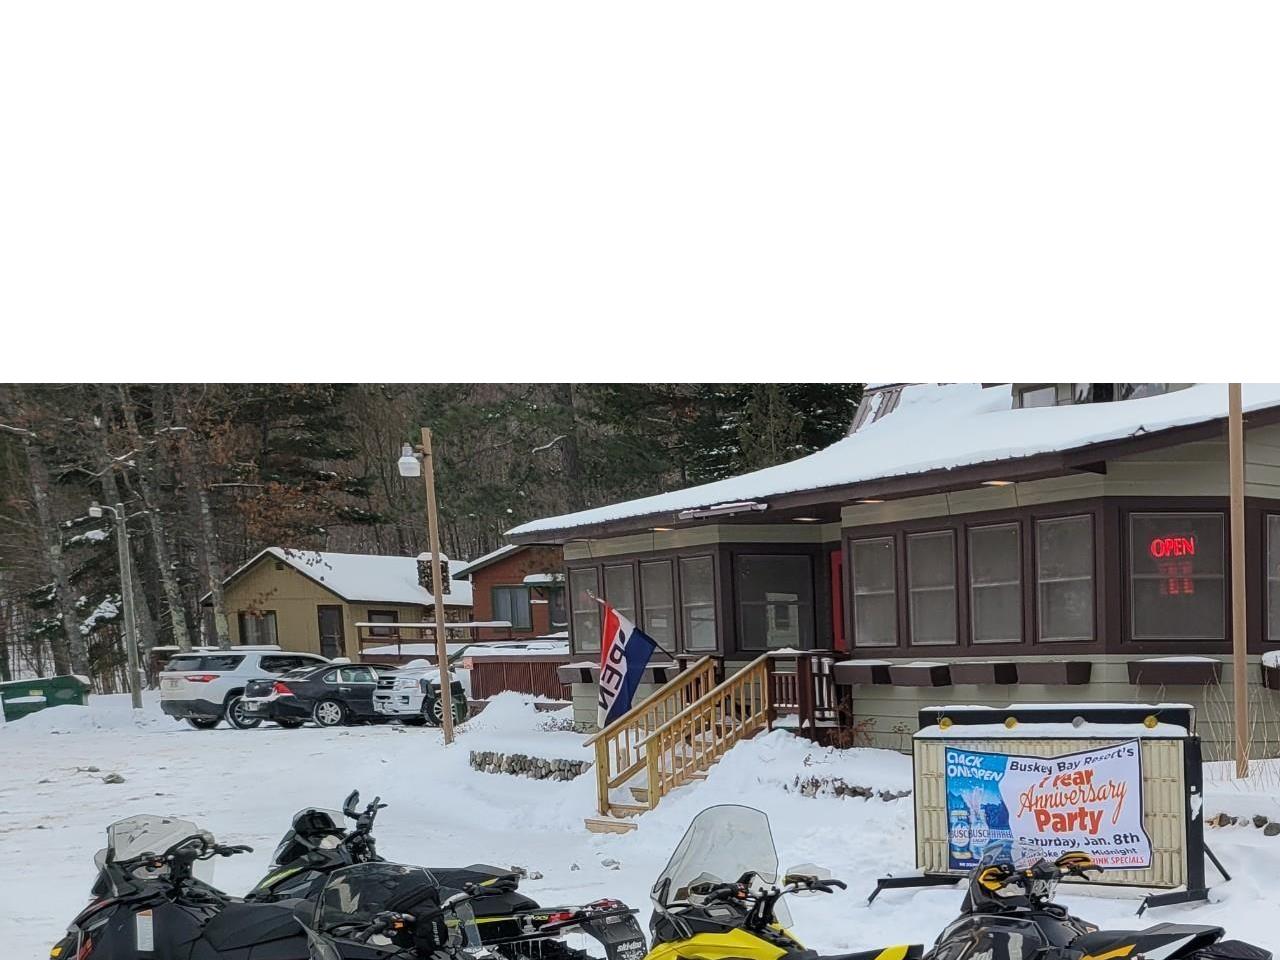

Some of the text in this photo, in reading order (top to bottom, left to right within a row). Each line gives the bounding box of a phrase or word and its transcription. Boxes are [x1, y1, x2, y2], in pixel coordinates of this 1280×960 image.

[1150, 536, 1195, 557] OPEN
[1010, 761, 1052, 775] Buskey
[1057, 760, 1080, 772] Bay
[1017, 780, 1126, 824] Anniversary
[1034, 807, 1104, 835] Party
[1084, 837, 1110, 846] Jan.
[1114, 833, 1140, 844] 8th
[1091, 848, 1137, 859] Midnight
